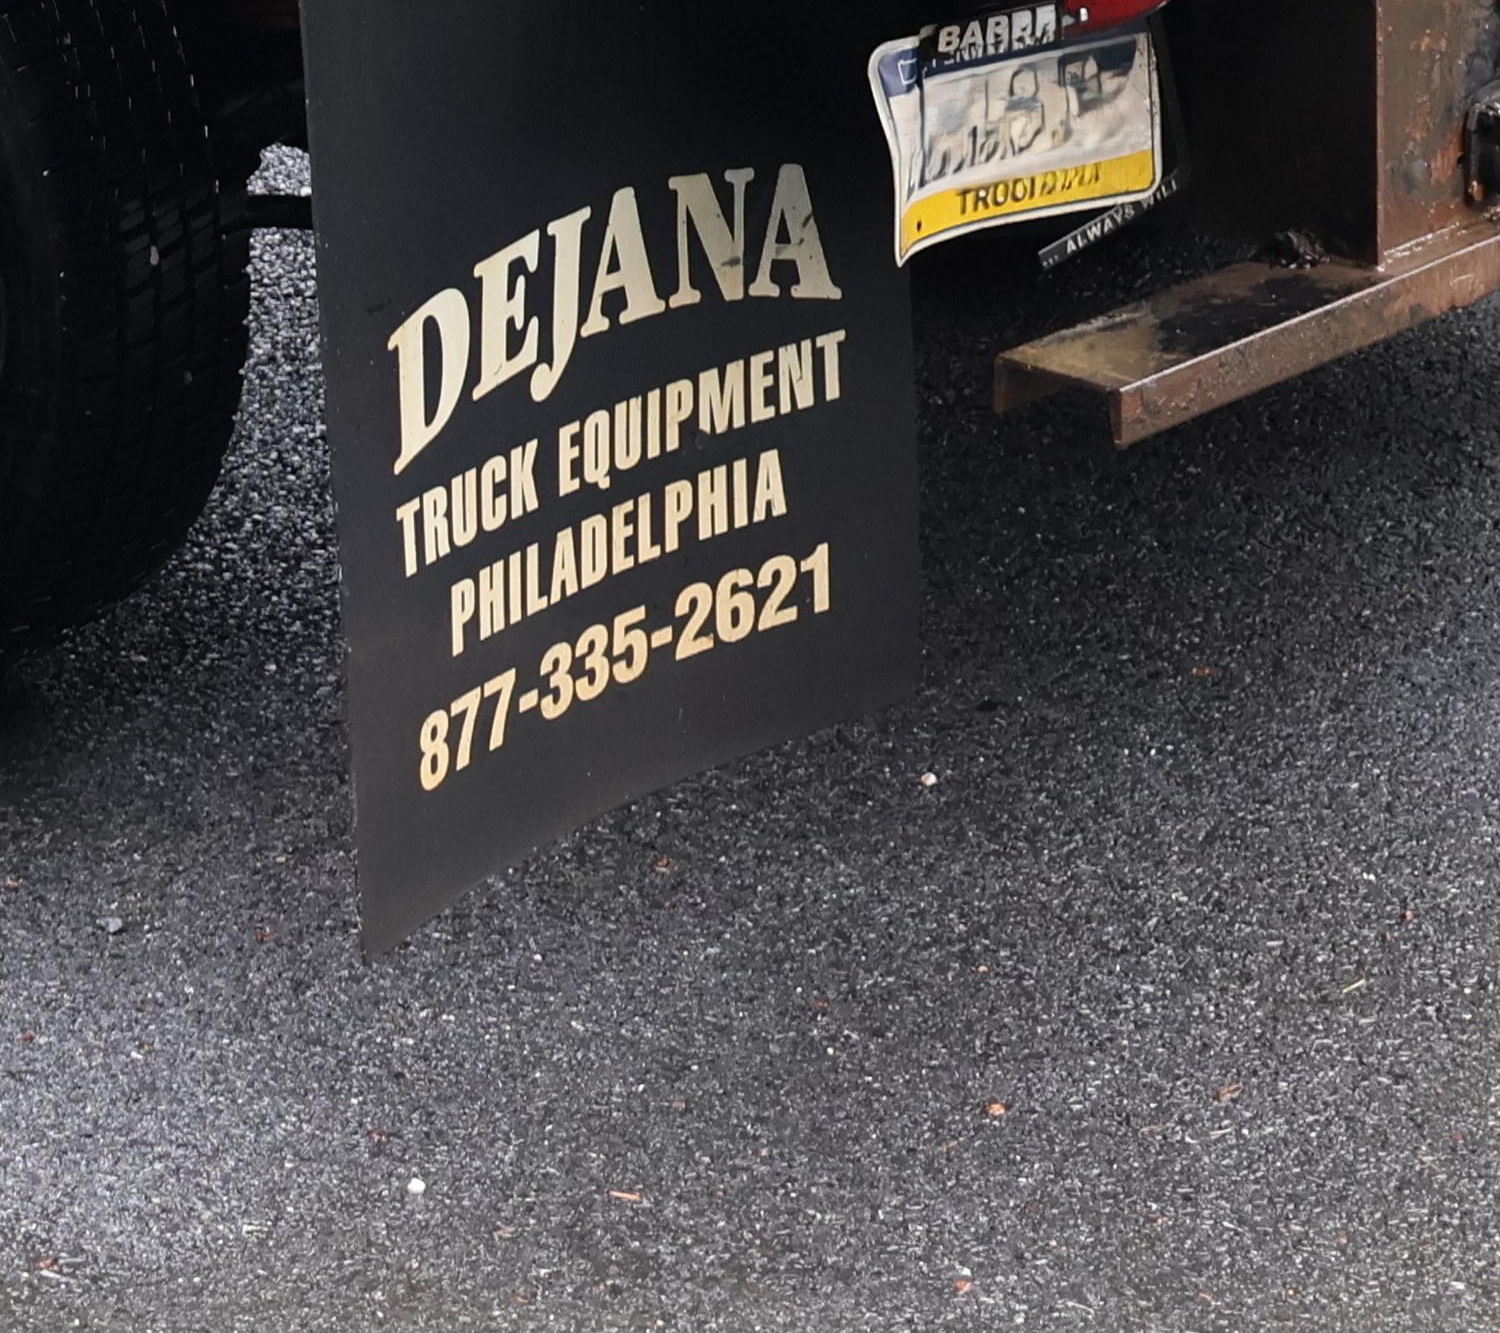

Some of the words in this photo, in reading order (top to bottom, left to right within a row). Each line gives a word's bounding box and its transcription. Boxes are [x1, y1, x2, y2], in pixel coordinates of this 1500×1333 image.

[386, 162, 843, 476] DEJANA
[1066, 203, 1135, 255] ALWAYS
[395, 439, 541, 578] TRUCK
[556, 329, 846, 497] EQUIPMENT
[450, 448, 787, 657] PHILADELPHIA
[418, 542, 831, 792] 877-335-2621
